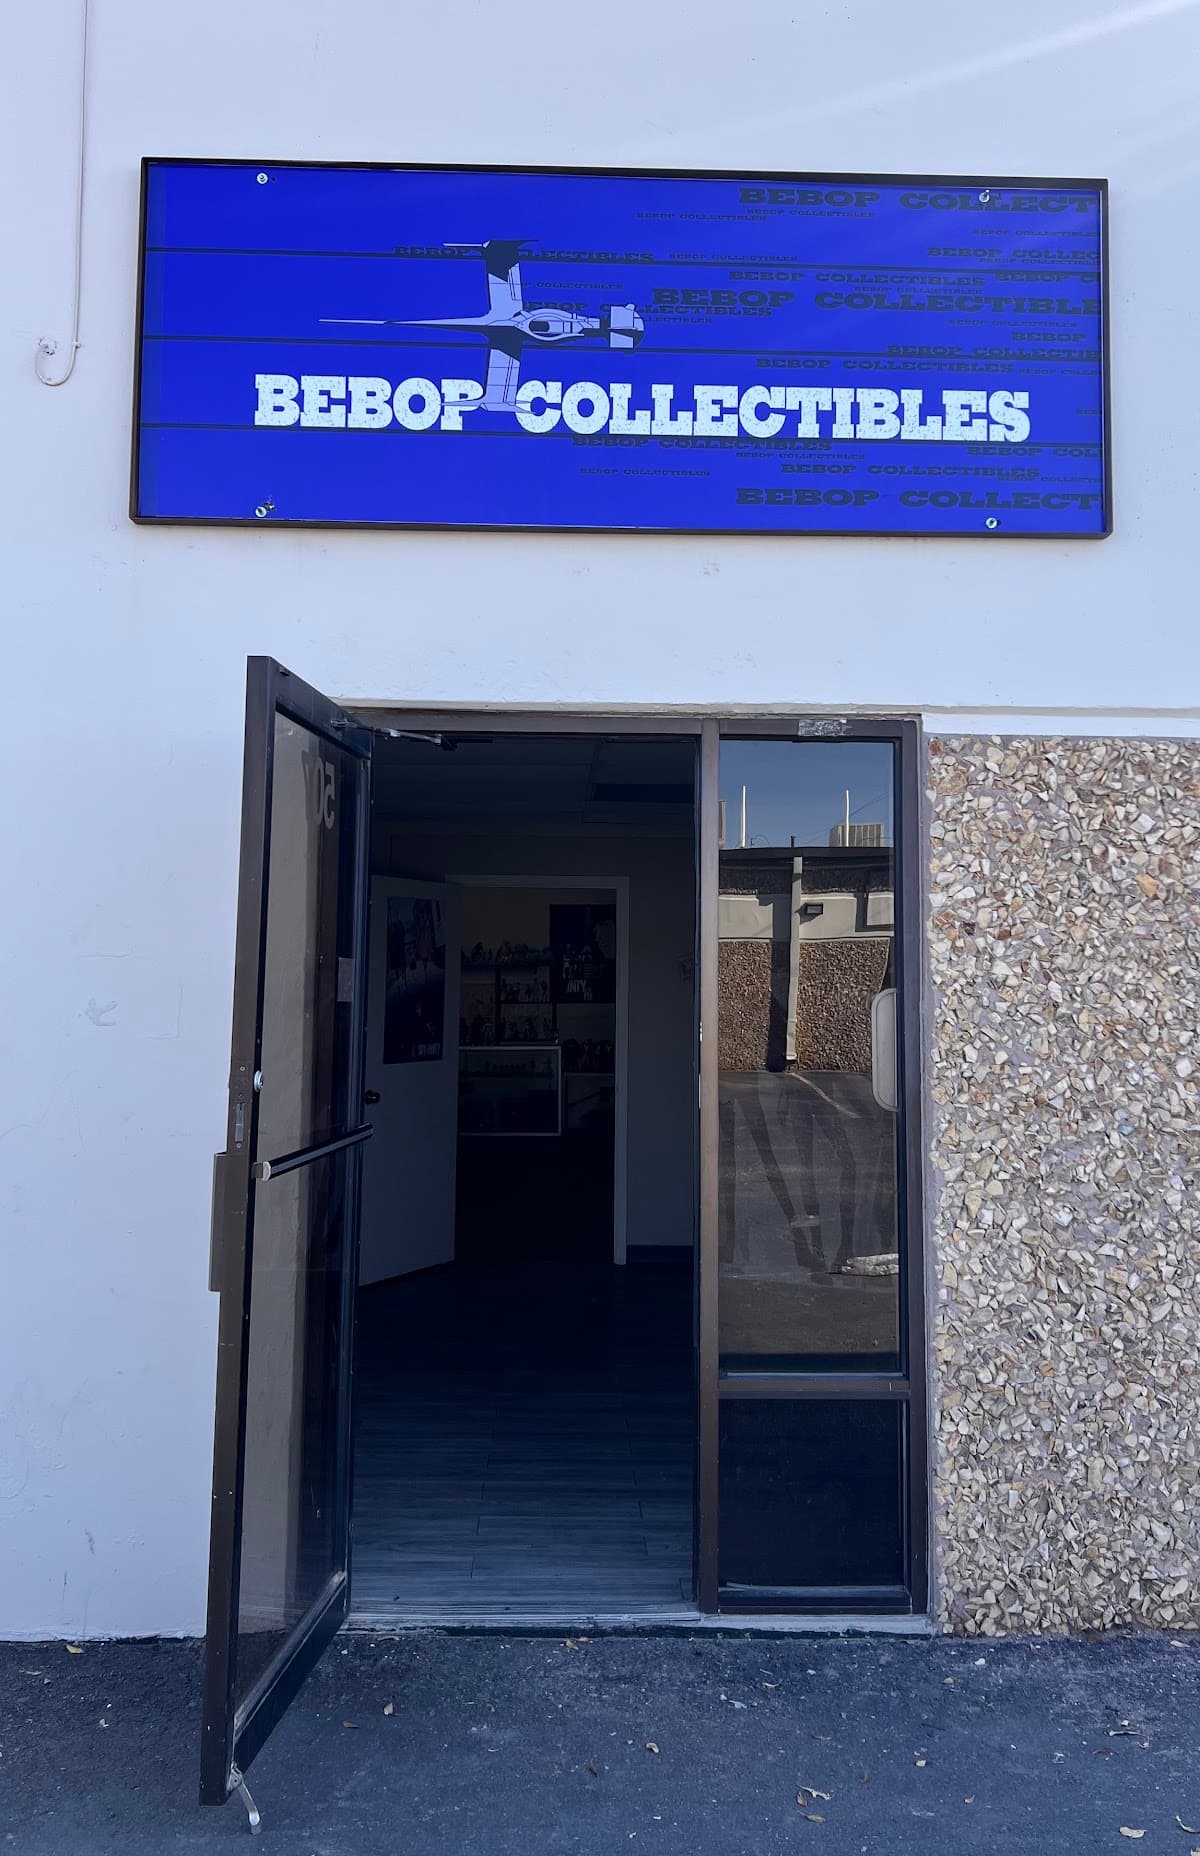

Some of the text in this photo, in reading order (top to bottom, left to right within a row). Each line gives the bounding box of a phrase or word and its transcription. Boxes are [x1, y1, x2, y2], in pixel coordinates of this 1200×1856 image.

[740, 187, 879, 207] BEBOP
[928, 247, 1001, 257] BEBOP
[728, 271, 985, 286] BEBOP COLLECTIBLES
[652, 288, 794, 307] BEBOP
[1012, 331, 1086, 342] BEBOP
[887, 345, 961, 358] BEBOP
[756, 359, 1013, 372] BEBOP COLLECTIBLES
[254, 373, 1030, 443] BEBOP COLLECTIBLES
[573, 436, 648, 447] BEBOP
[967, 446, 1042, 456] BEBOP
[781, 463, 1040, 480] BEBOP COLLECTIBLES
[736, 487, 880, 507] BEBOP
